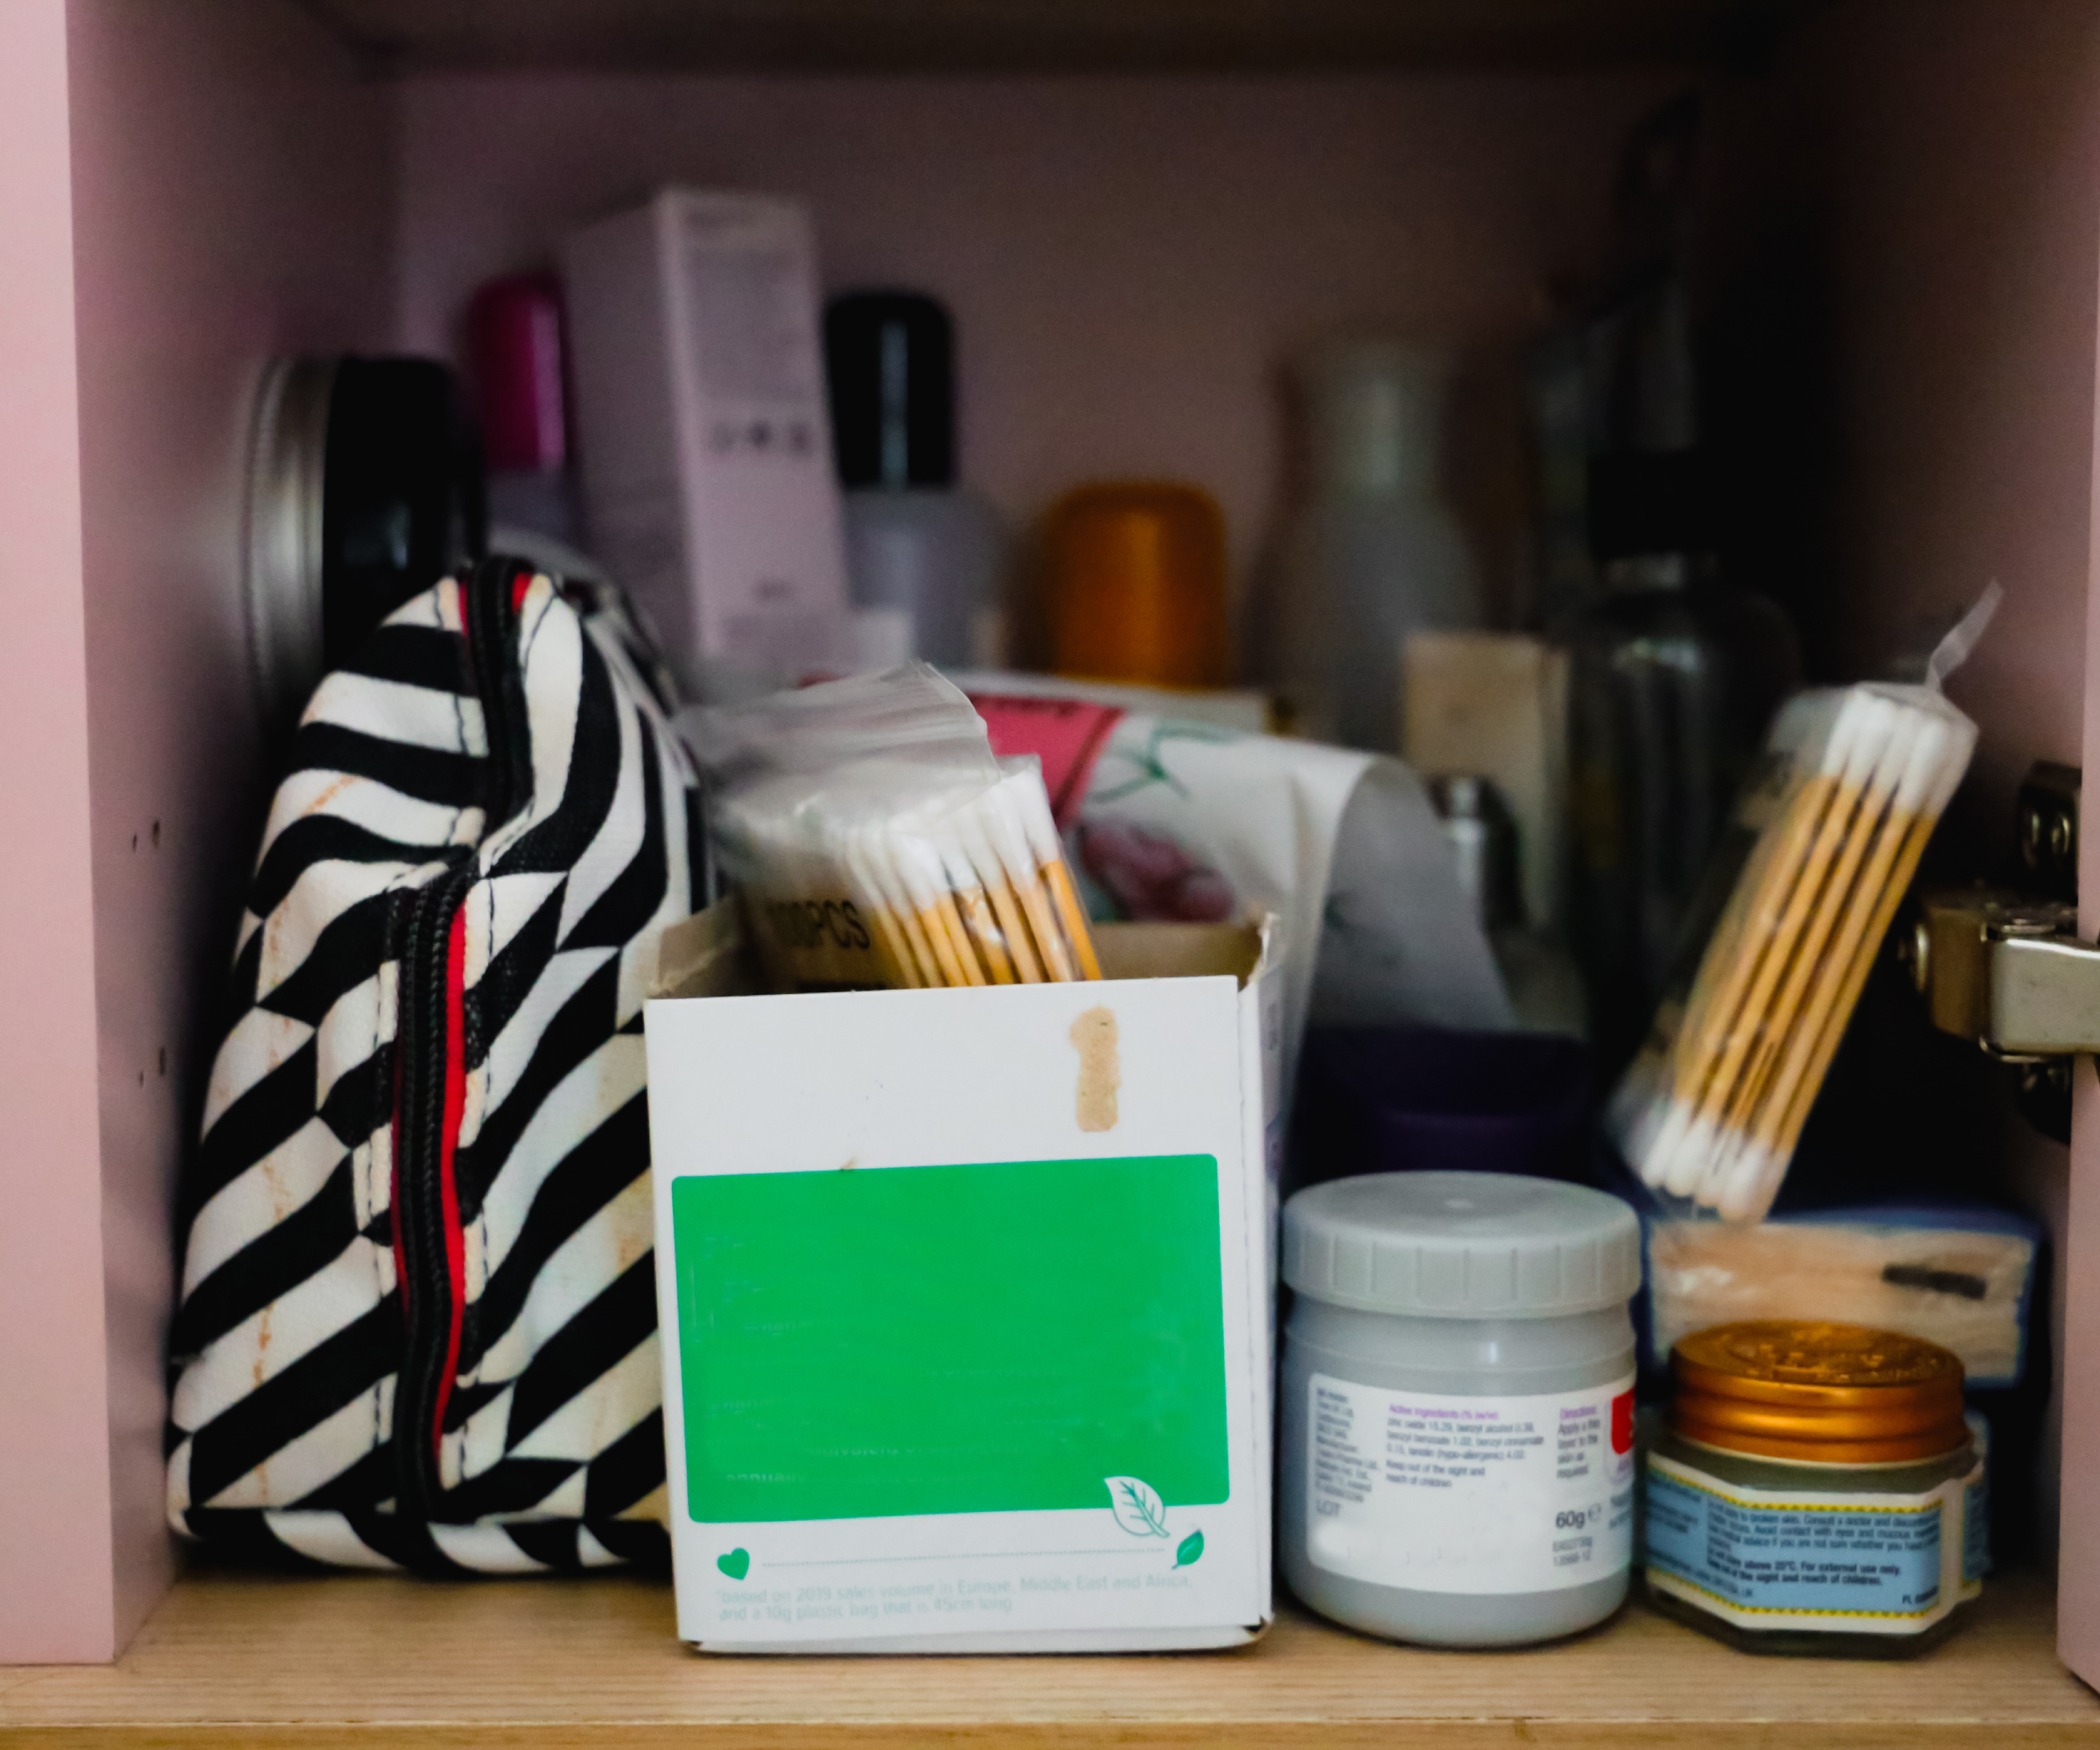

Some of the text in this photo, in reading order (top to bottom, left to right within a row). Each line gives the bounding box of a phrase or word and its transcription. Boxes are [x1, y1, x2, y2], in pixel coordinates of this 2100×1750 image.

[1415, 1407, 1459, 1419] ingredients
[1556, 1510, 1585, 1530] 60g
[1750, 1514, 1779, 1523] broken
[1803, 1514, 1835, 1525] Consult
[1845, 1516, 1872, 1526] doctor
[1874, 1516, 1891, 1526] and
[1754, 1525, 1777, 1535] Avoid
[1780, 1527, 1811, 1536] contact
[1814, 1527, 1831, 1536] with
[1836, 1529, 1854, 1538] eyes
[1858, 1529, 1874, 1537] and
[1780, 1539, 1795, 1548] you
[1744, 1560, 1772, 1570] above
[1801, 1562, 1815, 1572] For
[1818, 1563, 1857, 1572] external
[1859, 1564, 1877, 1573] use
[1756, 1573, 1779, 1584] sight
[1782, 1573, 1799, 1582] and
[1802, 1575, 1827, 1584] reach
[1830, 1574, 1840, 1583] of
[796, 1586, 831, 1602] 2019
[836, 1586, 875, 1600] sales
[880, 1583, 934, 1598] volume
[940, 1580, 953, 1594] in
[1020, 1575, 1071, 1591] Middle
[1076, 1574, 1108, 1590] East
[1112, 1575, 1141, 1589] and
[719, 1597, 1012, 1624] and a 10g plastic bag that is 45cm long
